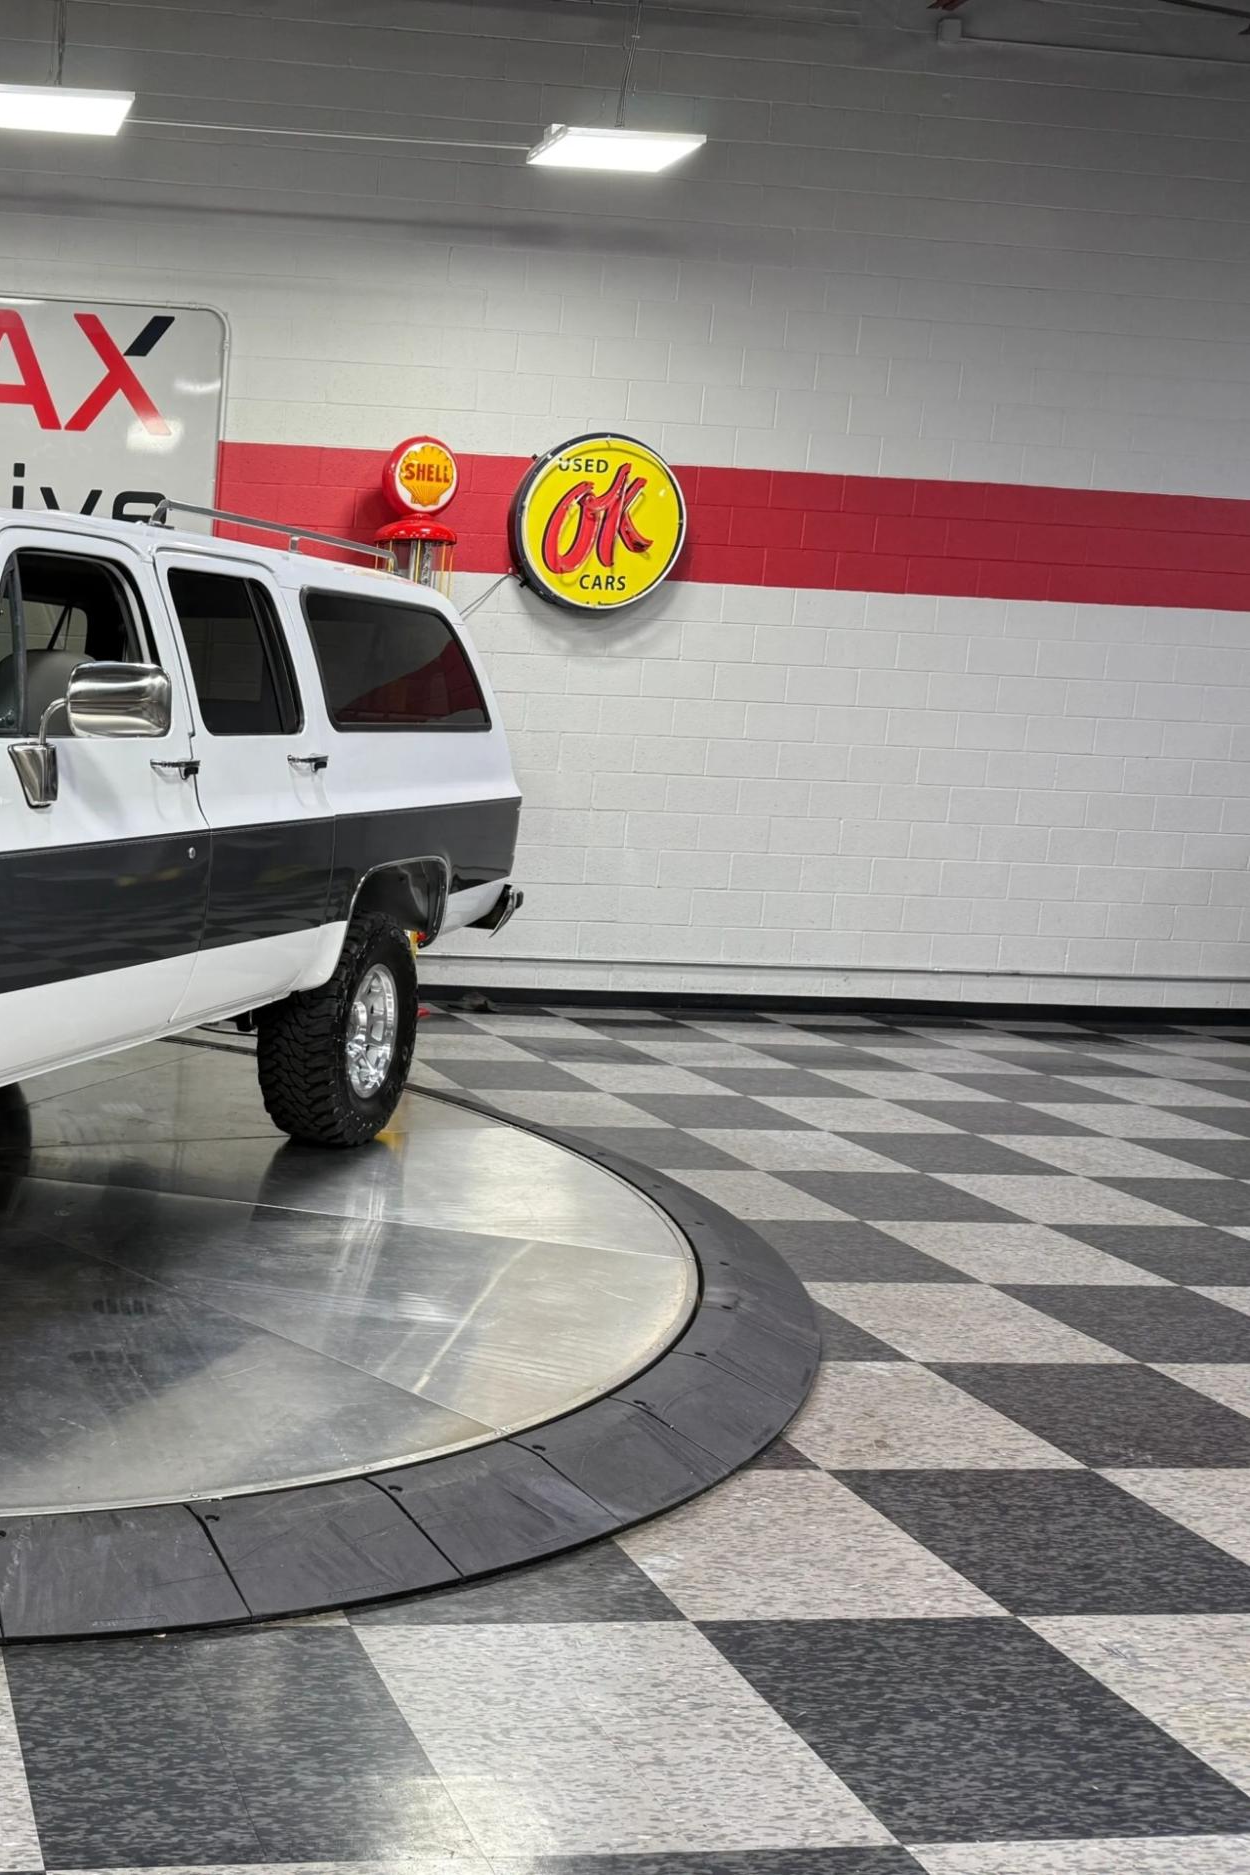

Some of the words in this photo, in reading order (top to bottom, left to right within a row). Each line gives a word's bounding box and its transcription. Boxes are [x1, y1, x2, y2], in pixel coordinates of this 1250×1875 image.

[404, 462, 450, 484] SHELL
[558, 458, 609, 474] USED
[541, 463, 654, 574] OK
[579, 574, 627, 592] CARS
